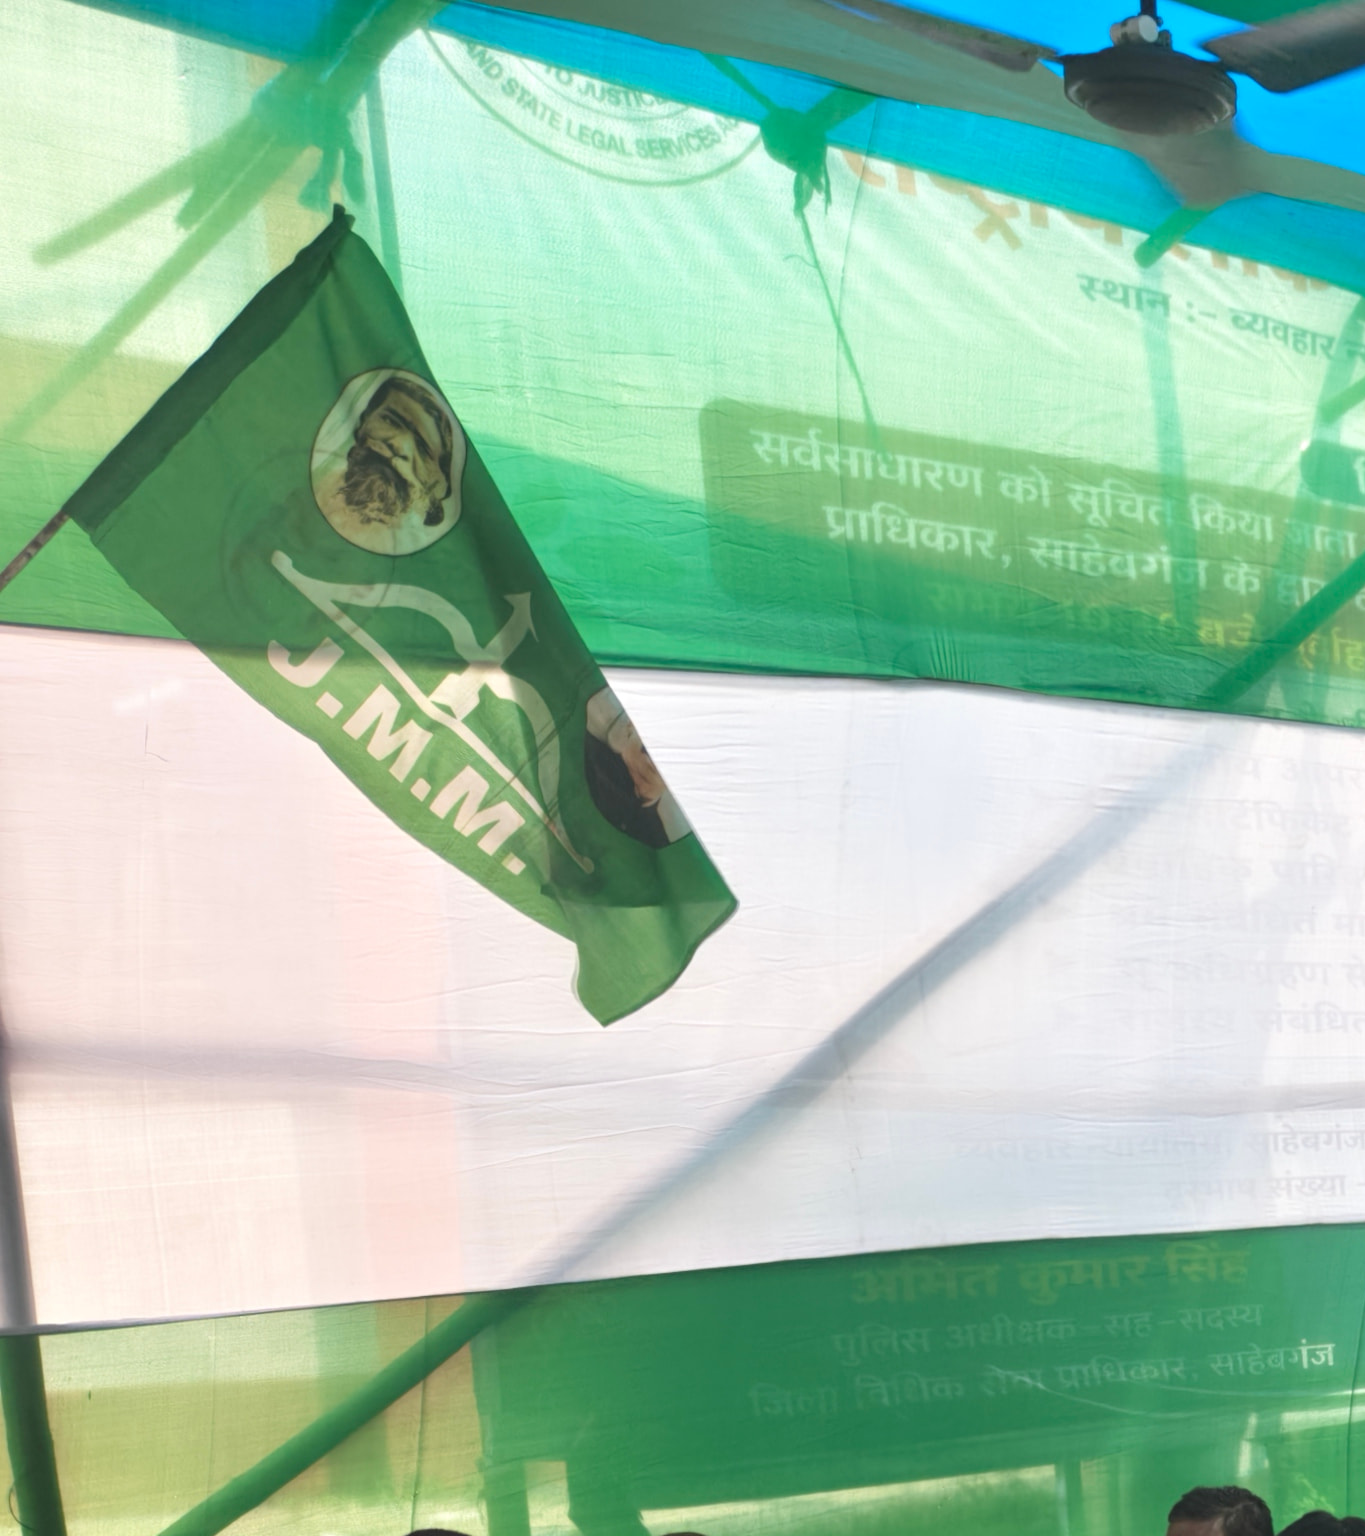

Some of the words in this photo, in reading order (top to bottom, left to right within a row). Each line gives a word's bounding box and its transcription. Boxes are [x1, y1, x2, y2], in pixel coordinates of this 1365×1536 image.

[501, 77, 563, 131] STATE
[565, 118, 634, 158] LEGAL
[635, 124, 722, 160] SERVICES
[577, 85, 667, 108] JUSTIC
[1077, 272, 1171, 320] स्थान
[1229, 307, 1336, 363] व्यवहार
[750, 427, 983, 499] सर्वसाधारण
[999, 462, 1053, 518] को
[1066, 474, 1173, 538] सूचित
[1191, 494, 1275, 543] किया
[822, 500, 1012, 570] प्राधिकार,
[1221, 555, 1261, 597] के
[267, 638, 527, 876] J.M.M.
[1208, 1338, 1337, 1380] साहेबगंज
